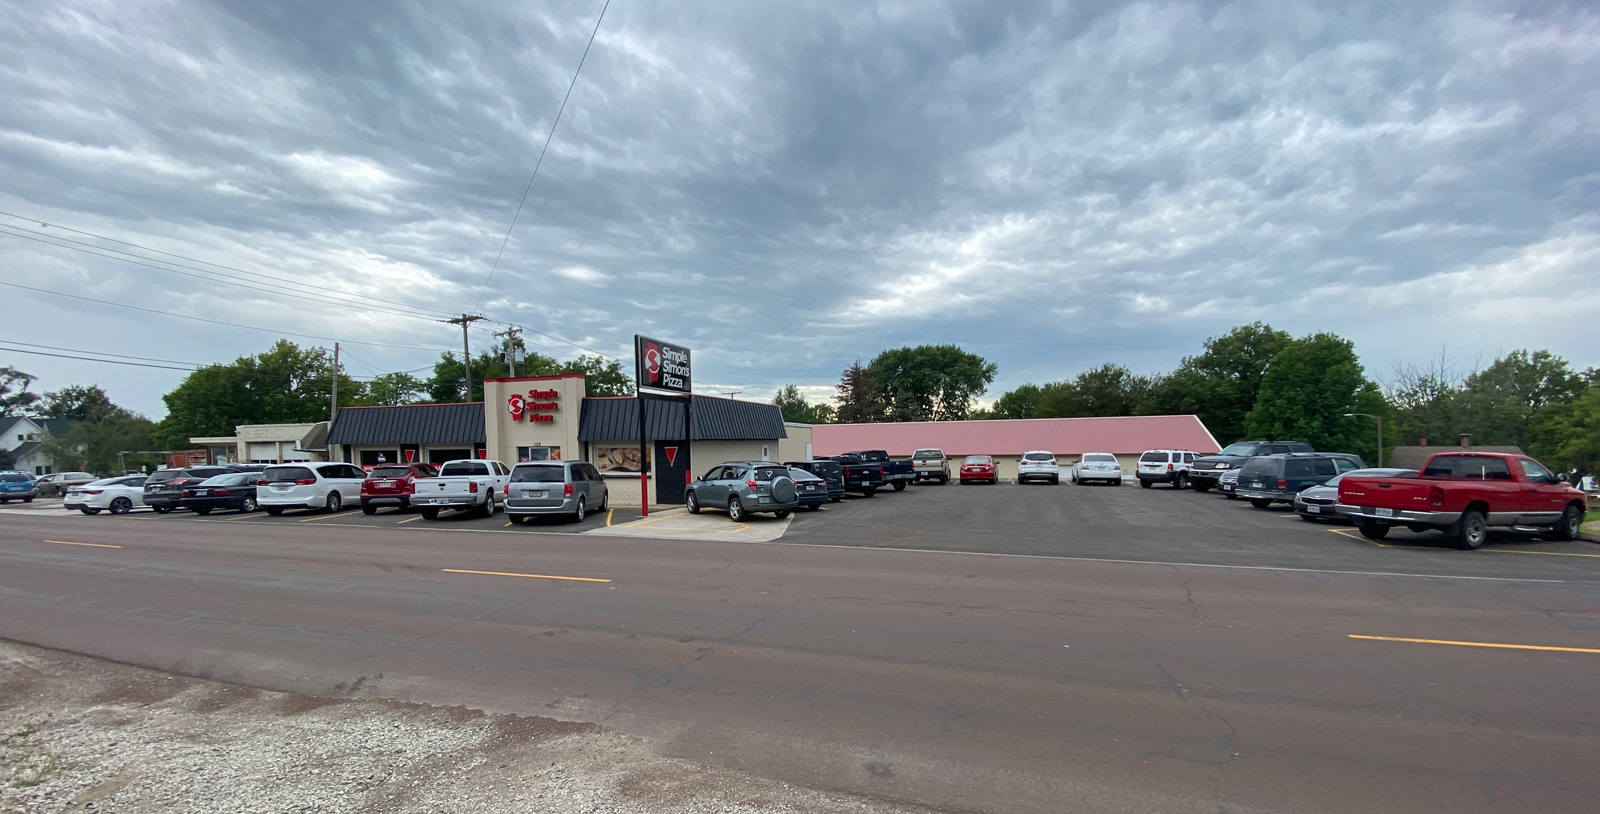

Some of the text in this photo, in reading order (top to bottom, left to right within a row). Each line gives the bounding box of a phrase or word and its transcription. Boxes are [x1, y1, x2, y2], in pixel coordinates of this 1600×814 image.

[662, 346, 688, 364] Simple
[662, 360, 690, 377] Simon's
[662, 373, 683, 388] Pizza
[528, 388, 558, 400] Simple
[525, 401, 558, 411] Simon's
[529, 413, 554, 423] Pizza
